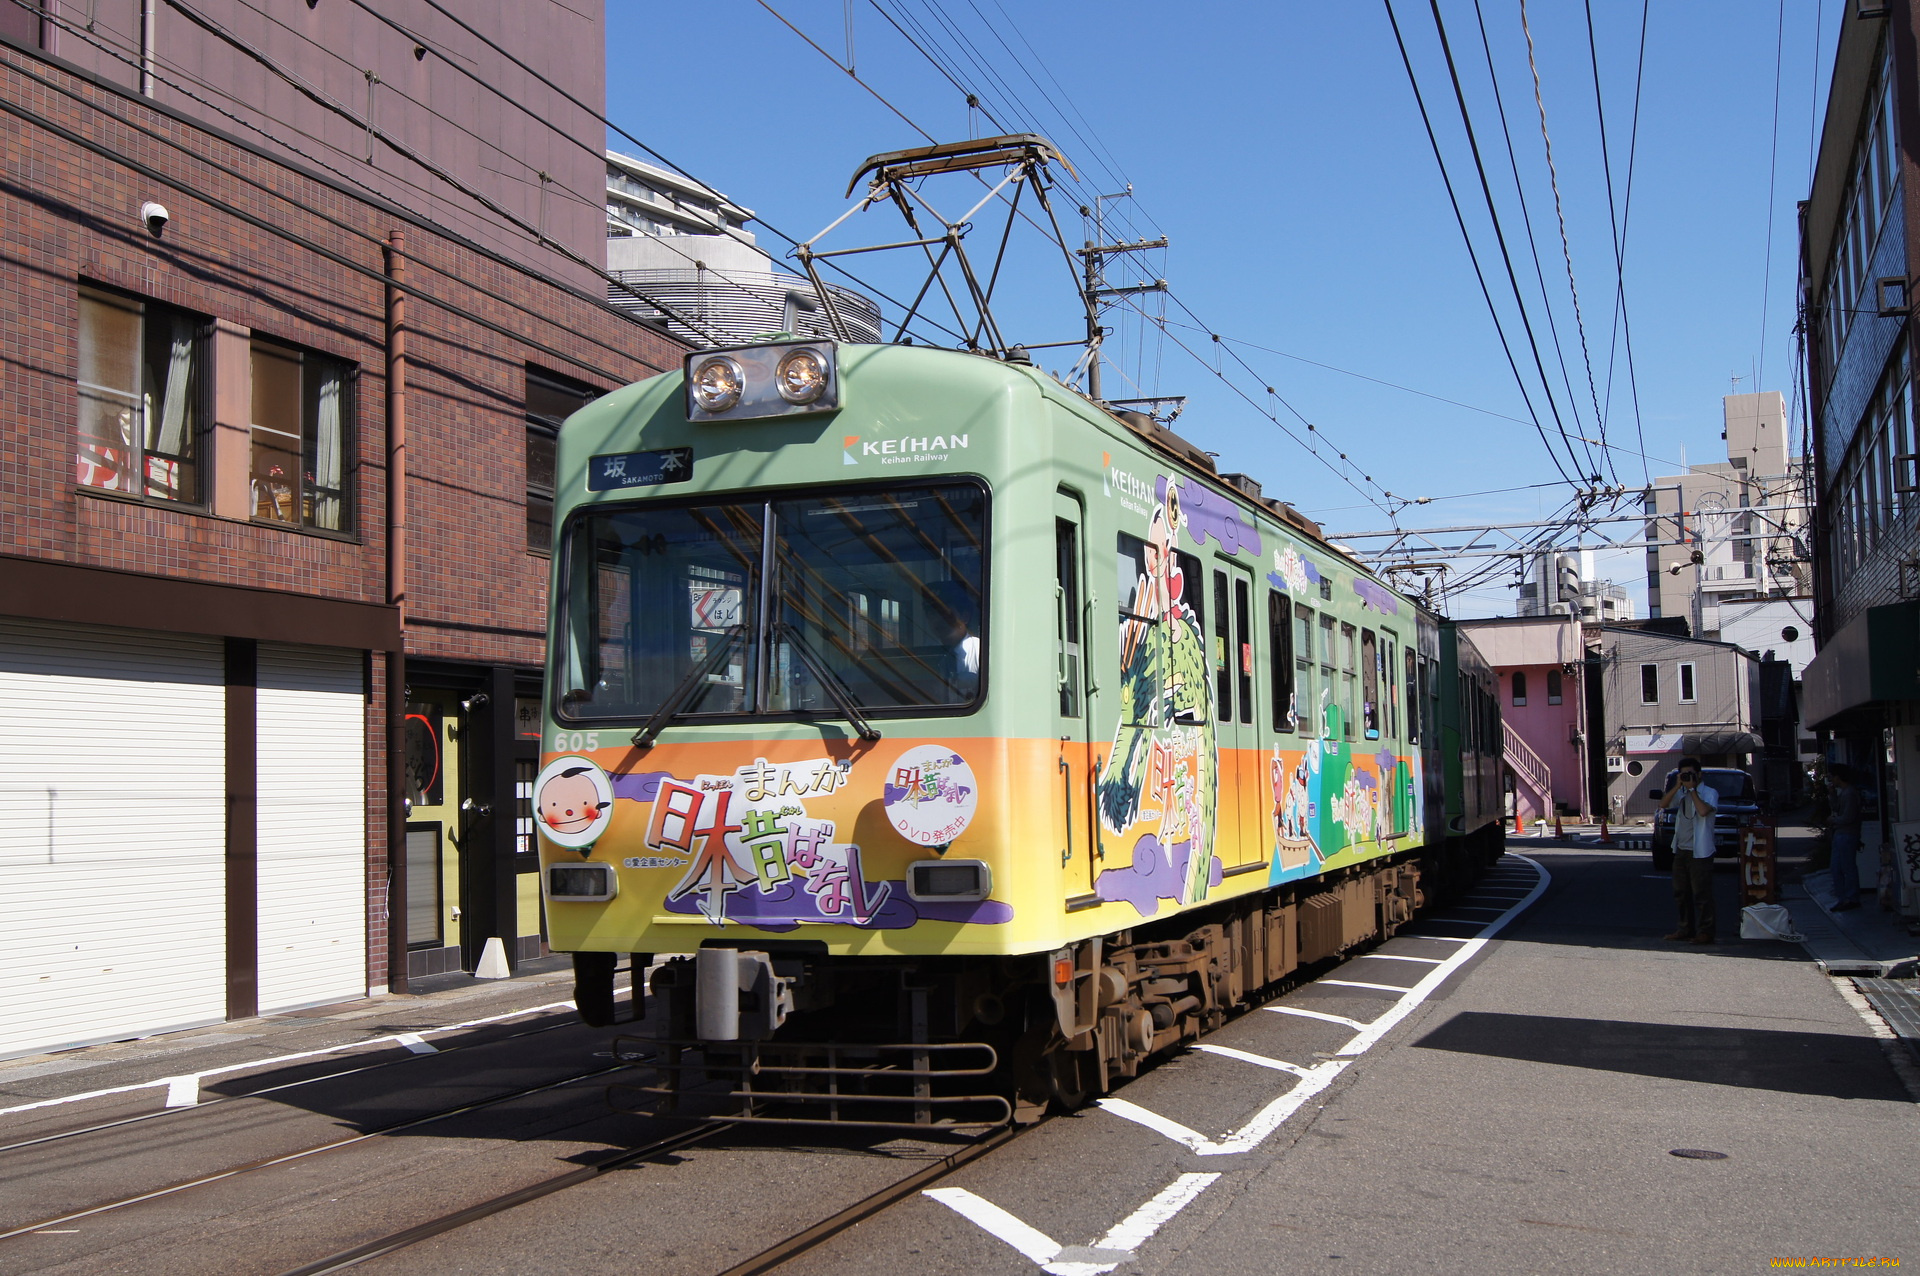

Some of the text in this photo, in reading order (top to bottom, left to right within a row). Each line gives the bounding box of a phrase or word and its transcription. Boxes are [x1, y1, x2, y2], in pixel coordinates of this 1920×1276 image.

[863, 434, 968, 455] KEIHAN
[604, 451, 684, 478] 坂本
[881, 453, 948, 464] Keihan Railway
[622, 474, 664, 485] SAKAMOTO
[1111, 467, 1154, 506] KEIHAN
[714, 609, 734, 620] ほし
[555, 732, 599, 752] 605
[921, 759, 953, 772] まんが
[740, 762, 849, 801] まんが
[898, 816, 965, 843] DVD発売中
[648, 782, 890, 928] 日本昔ばなし
